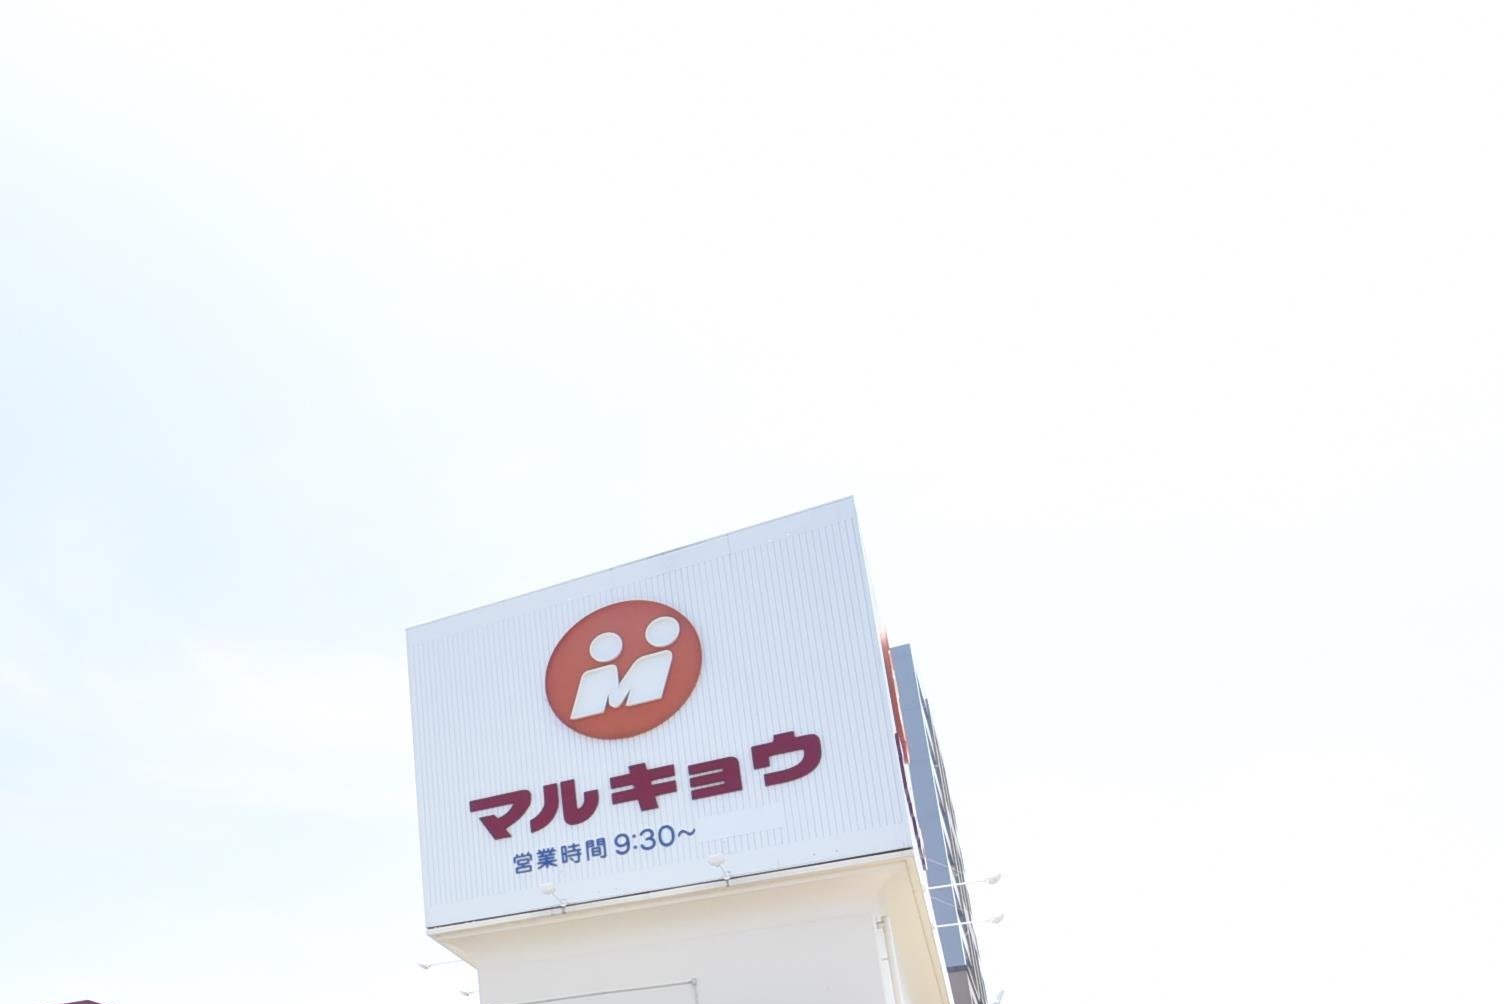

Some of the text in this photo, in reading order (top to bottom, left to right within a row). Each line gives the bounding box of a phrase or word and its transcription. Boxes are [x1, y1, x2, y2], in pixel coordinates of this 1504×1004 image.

[469, 731, 822, 840] マルキョウ
